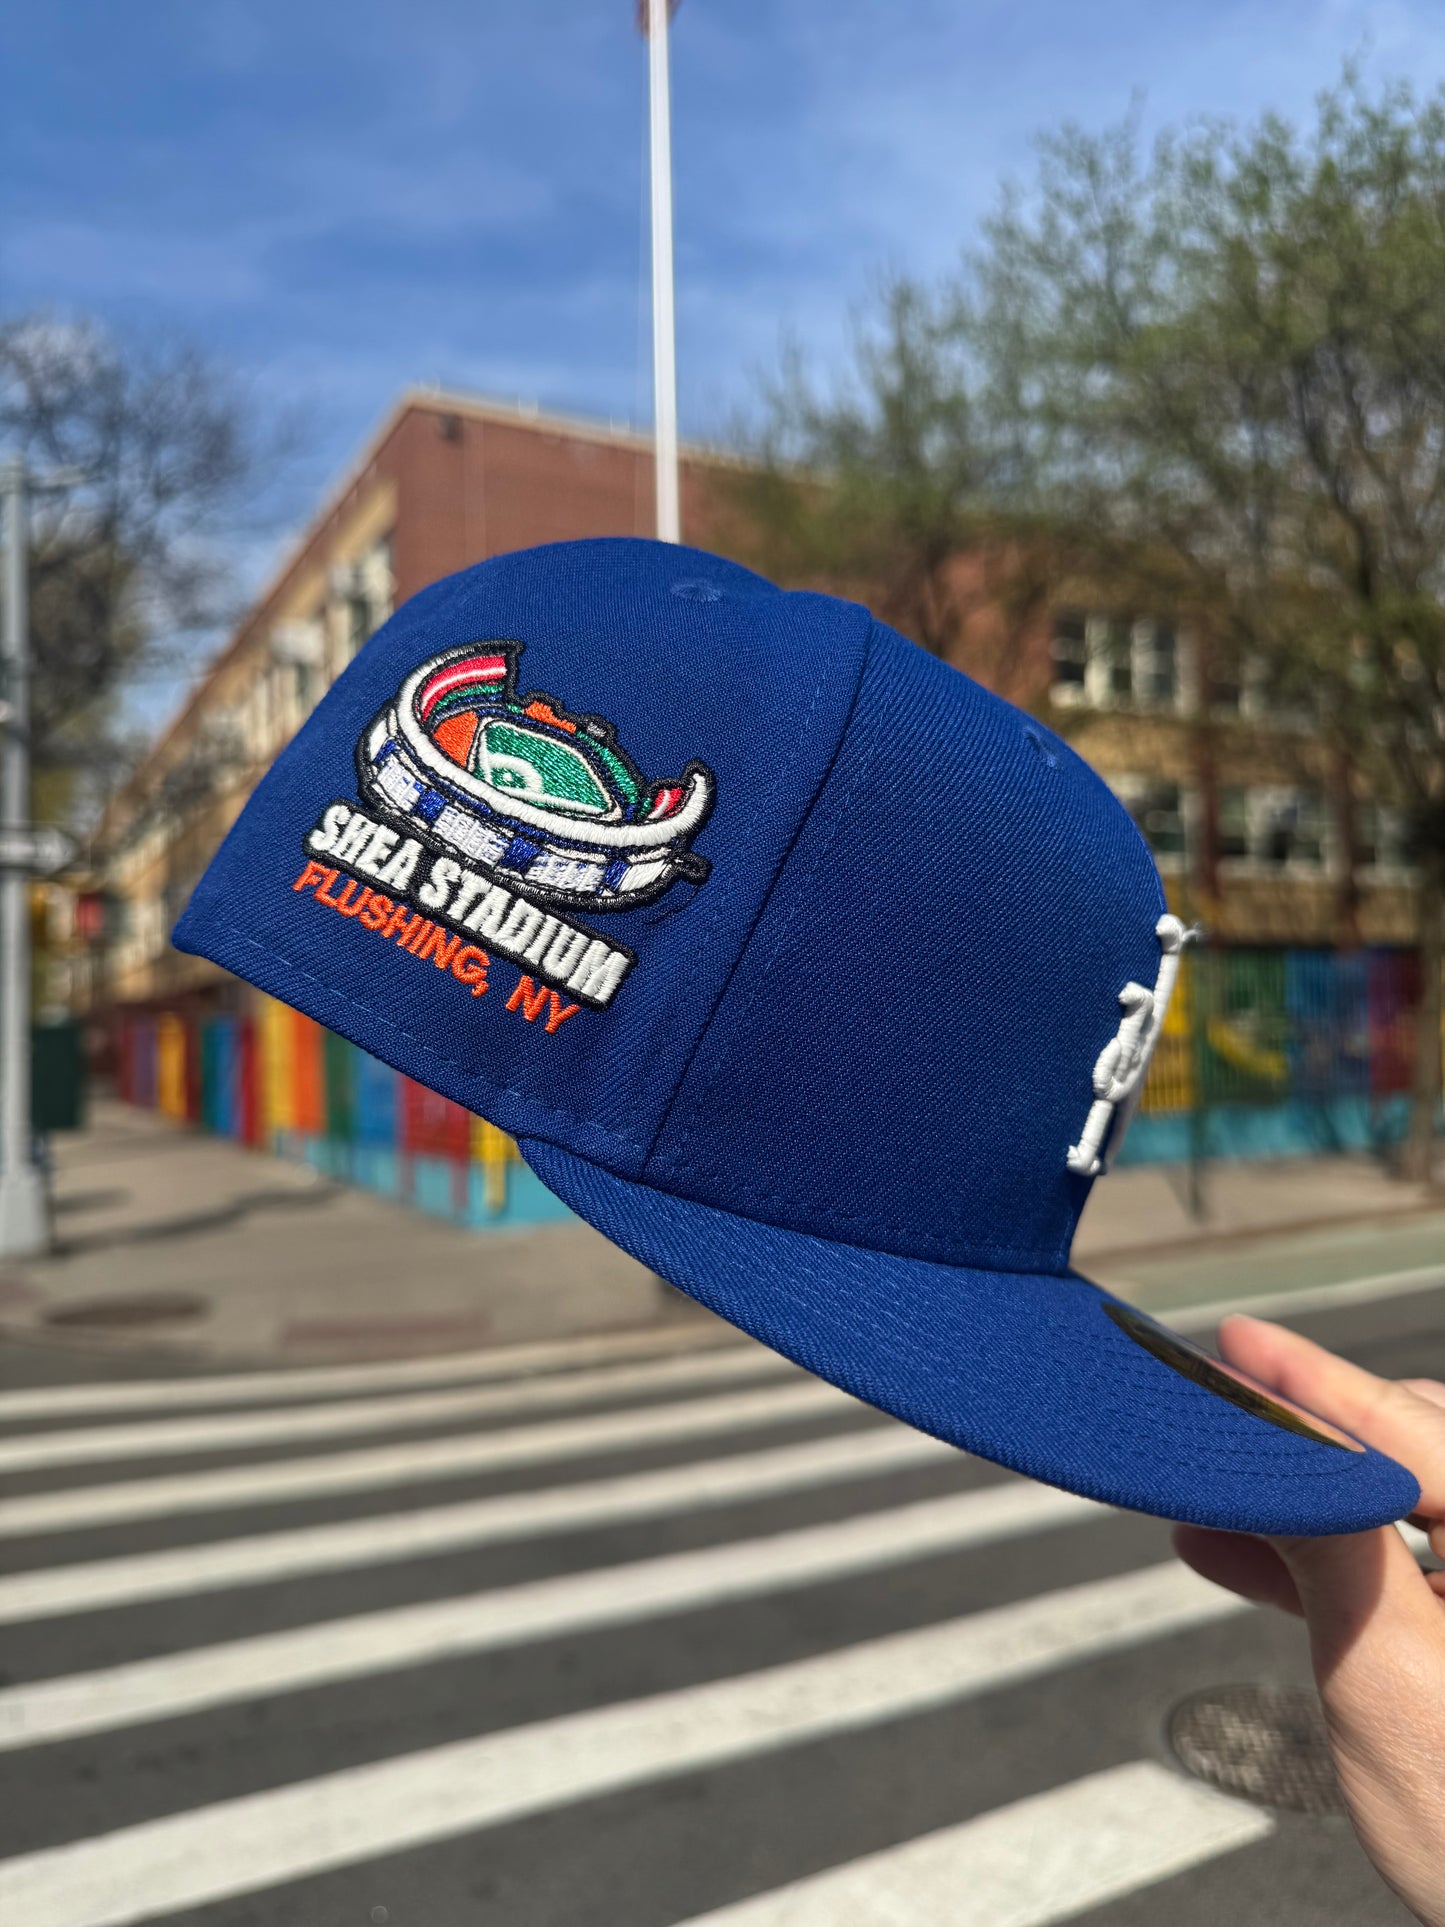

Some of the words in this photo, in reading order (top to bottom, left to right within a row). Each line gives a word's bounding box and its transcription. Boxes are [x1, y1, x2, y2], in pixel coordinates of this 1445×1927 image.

[292, 860, 491, 998] FLUSHING,
[505, 975, 582, 1034] NY
[309, 804, 422, 890] SHEA
[419, 857, 630, 1003] STADIUM
